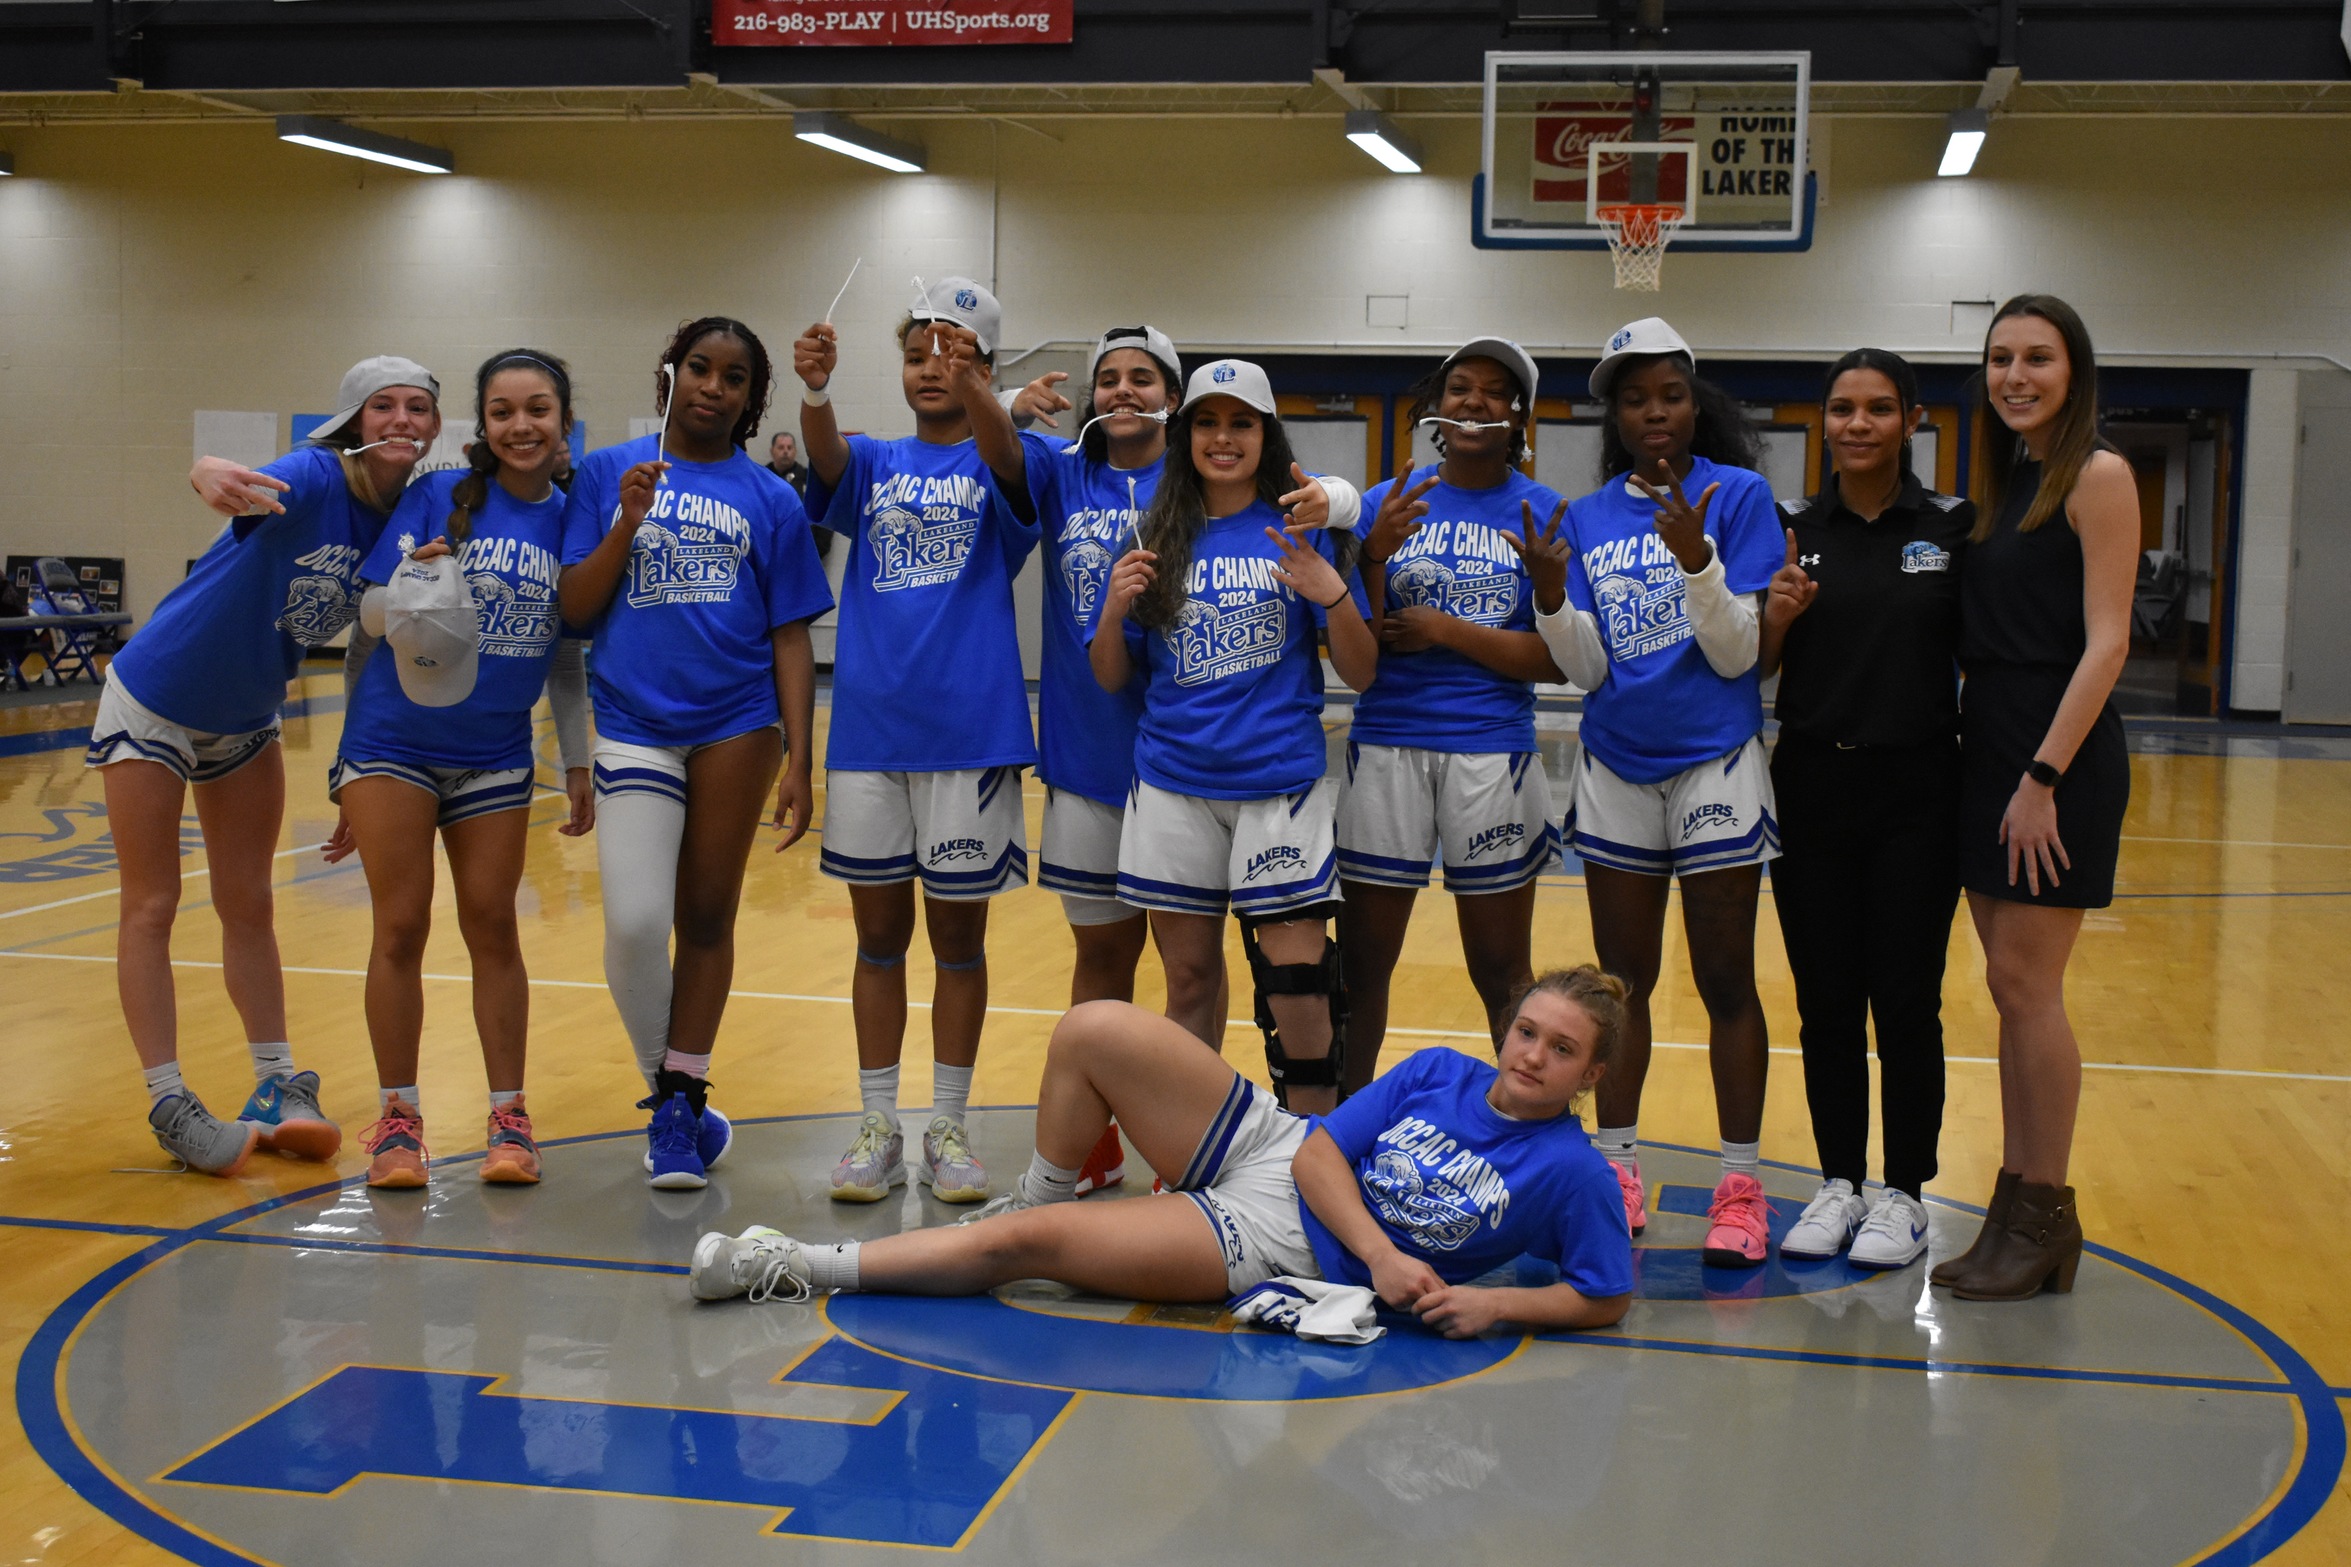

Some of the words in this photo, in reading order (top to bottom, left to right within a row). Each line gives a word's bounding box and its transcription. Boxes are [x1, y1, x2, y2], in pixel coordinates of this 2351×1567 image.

[733, 11, 885, 33] 216-983-PLAY
[905, 10, 1050, 33] UHSports.org
[1711, 138, 1746, 164] OF
[922, 506, 959, 521] 2024
[676, 492, 751, 558] CHAMPS
[680, 525, 717, 544] 2024
[923, 522, 975, 538] LAKELAND
[679, 547, 730, 555] LAKELAND
[1902, 552, 1949, 571] Lakers
[628, 548, 734, 601] Lakers
[1455, 559, 1494, 576] 2024
[910, 570, 960, 588] BASKETB
[1454, 576, 1509, 590] LAKELAND
[517, 580, 551, 602] 2024
[665, 591, 731, 604] BASKETBALL
[1218, 590, 1257, 608] 2024
[1647, 580, 1684, 601] LAKELA
[1221, 603, 1275, 625] LAKELAND
[1601, 593, 1688, 649] Laker
[484, 644, 547, 658] BASKETBALL
[1174, 614, 1282, 682] Lakers
[1214, 650, 1282, 680] BASKETBALL
[1683, 803, 1734, 832] LAKERS
[1468, 822, 1525, 852] LAKERS
[931, 838, 985, 859] LAKERS
[1247, 845, 1301, 873] LAKERS
[1377, 1116, 1457, 1167] OCCAC
[1437, 1148, 1510, 1230] CHAMPS
[1426, 1177, 1468, 1206] 2024
